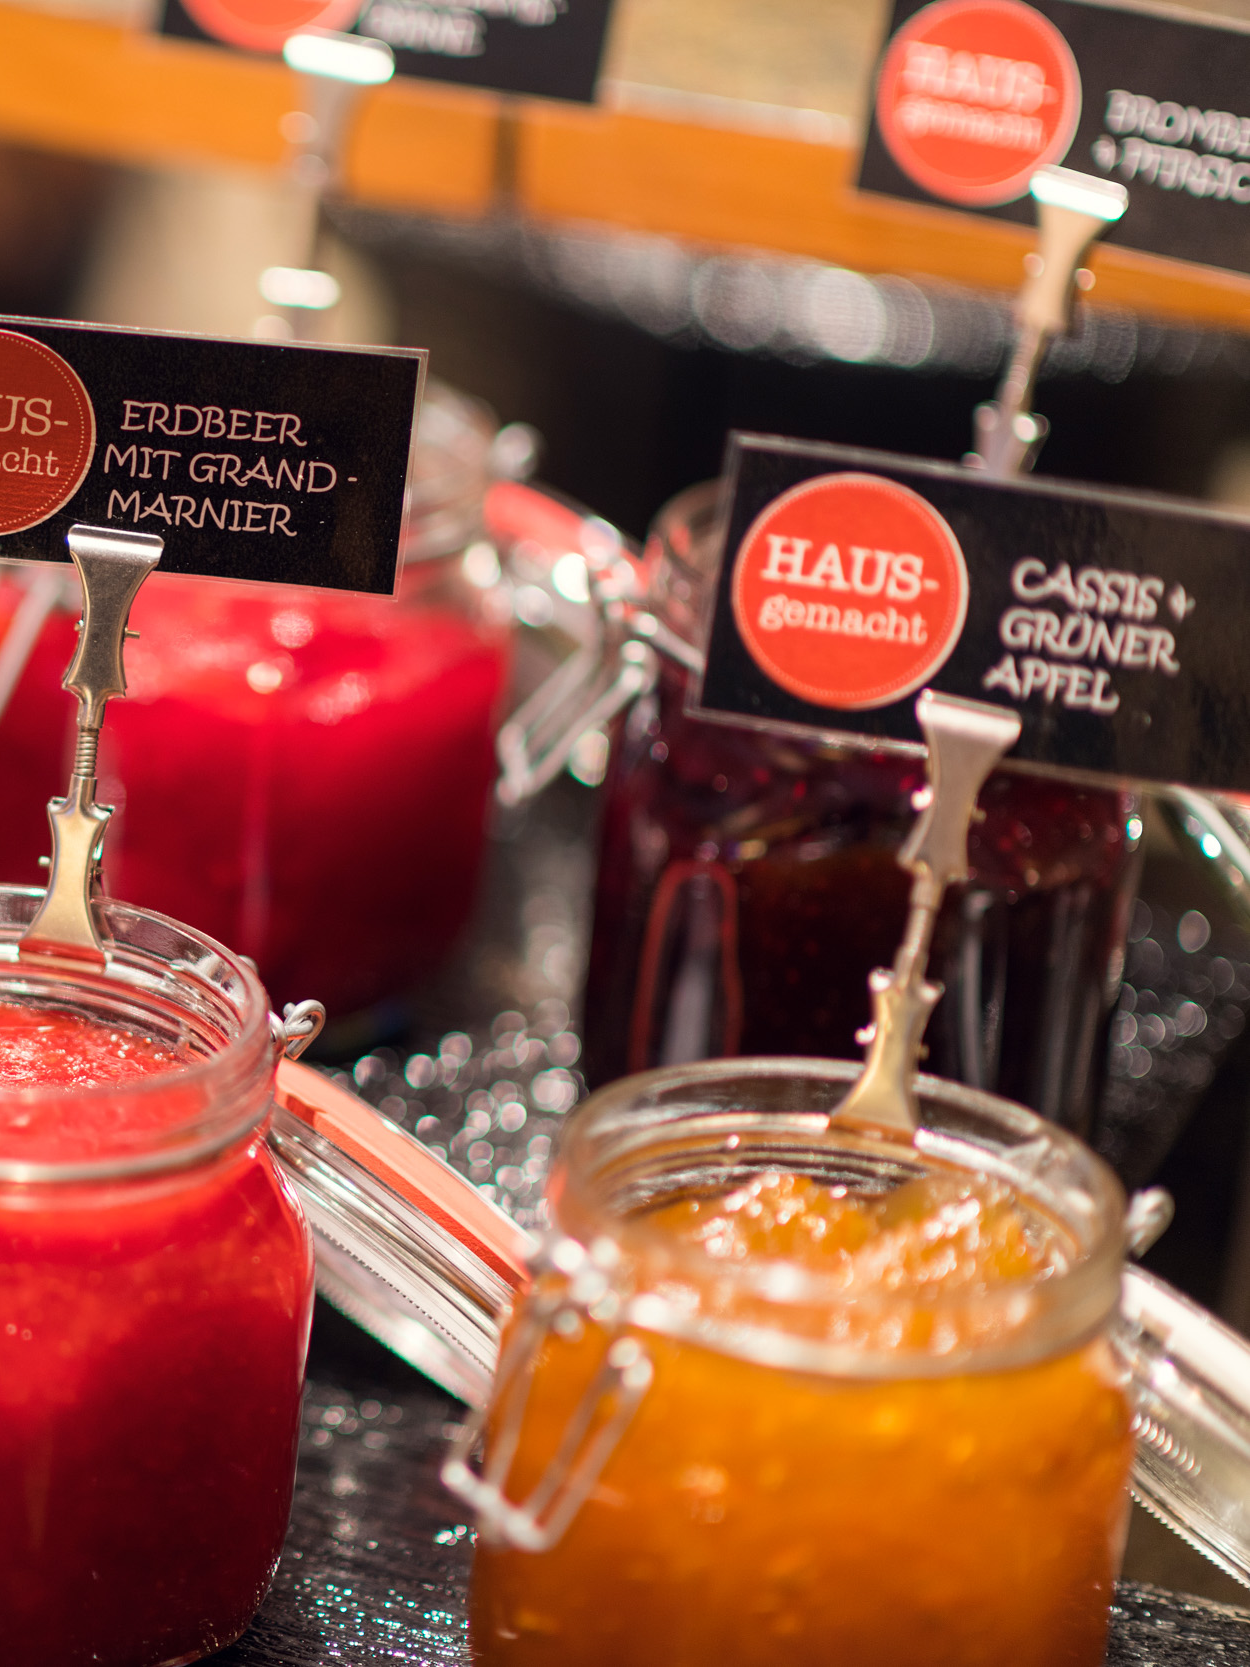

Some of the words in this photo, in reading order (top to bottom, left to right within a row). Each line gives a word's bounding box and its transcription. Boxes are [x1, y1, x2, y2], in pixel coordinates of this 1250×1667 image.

[119, 400, 308, 447] ERDBEER
[103, 443, 182, 479] MIT
[106, 489, 298, 537] MARNIER
[761, 534, 939, 600] HAUS-
[1011, 558, 1165, 620] CASSIS
[758, 594, 928, 645] gemacht
[999, 609, 1180, 674] GRÜNER
[983, 655, 1120, 713] APFEL
